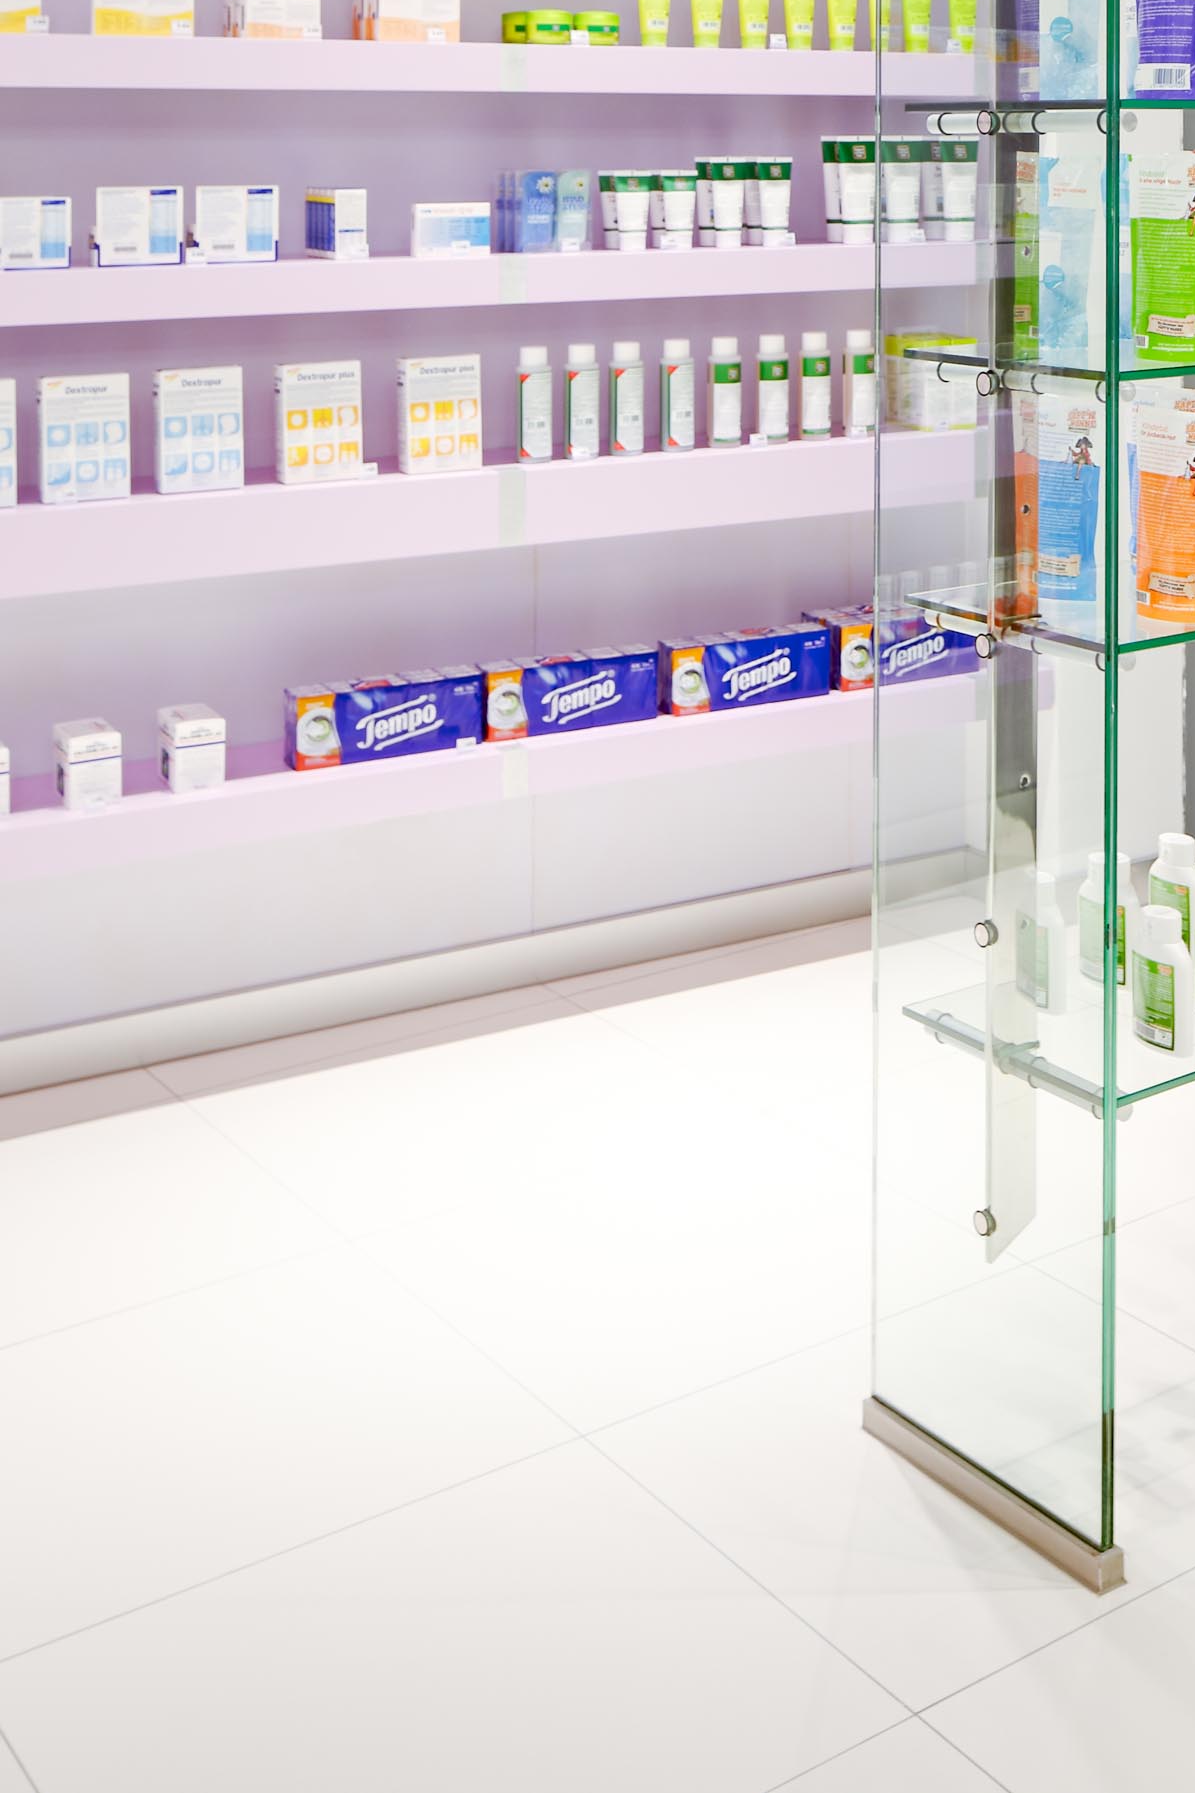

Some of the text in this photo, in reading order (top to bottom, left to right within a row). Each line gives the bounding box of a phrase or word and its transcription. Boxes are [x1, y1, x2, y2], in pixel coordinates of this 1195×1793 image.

[721, 649, 797, 702] Tempo
[882, 628, 949, 677] Tempo
[355, 695, 444, 751] Tempo
[541, 671, 622, 724] Tempo
